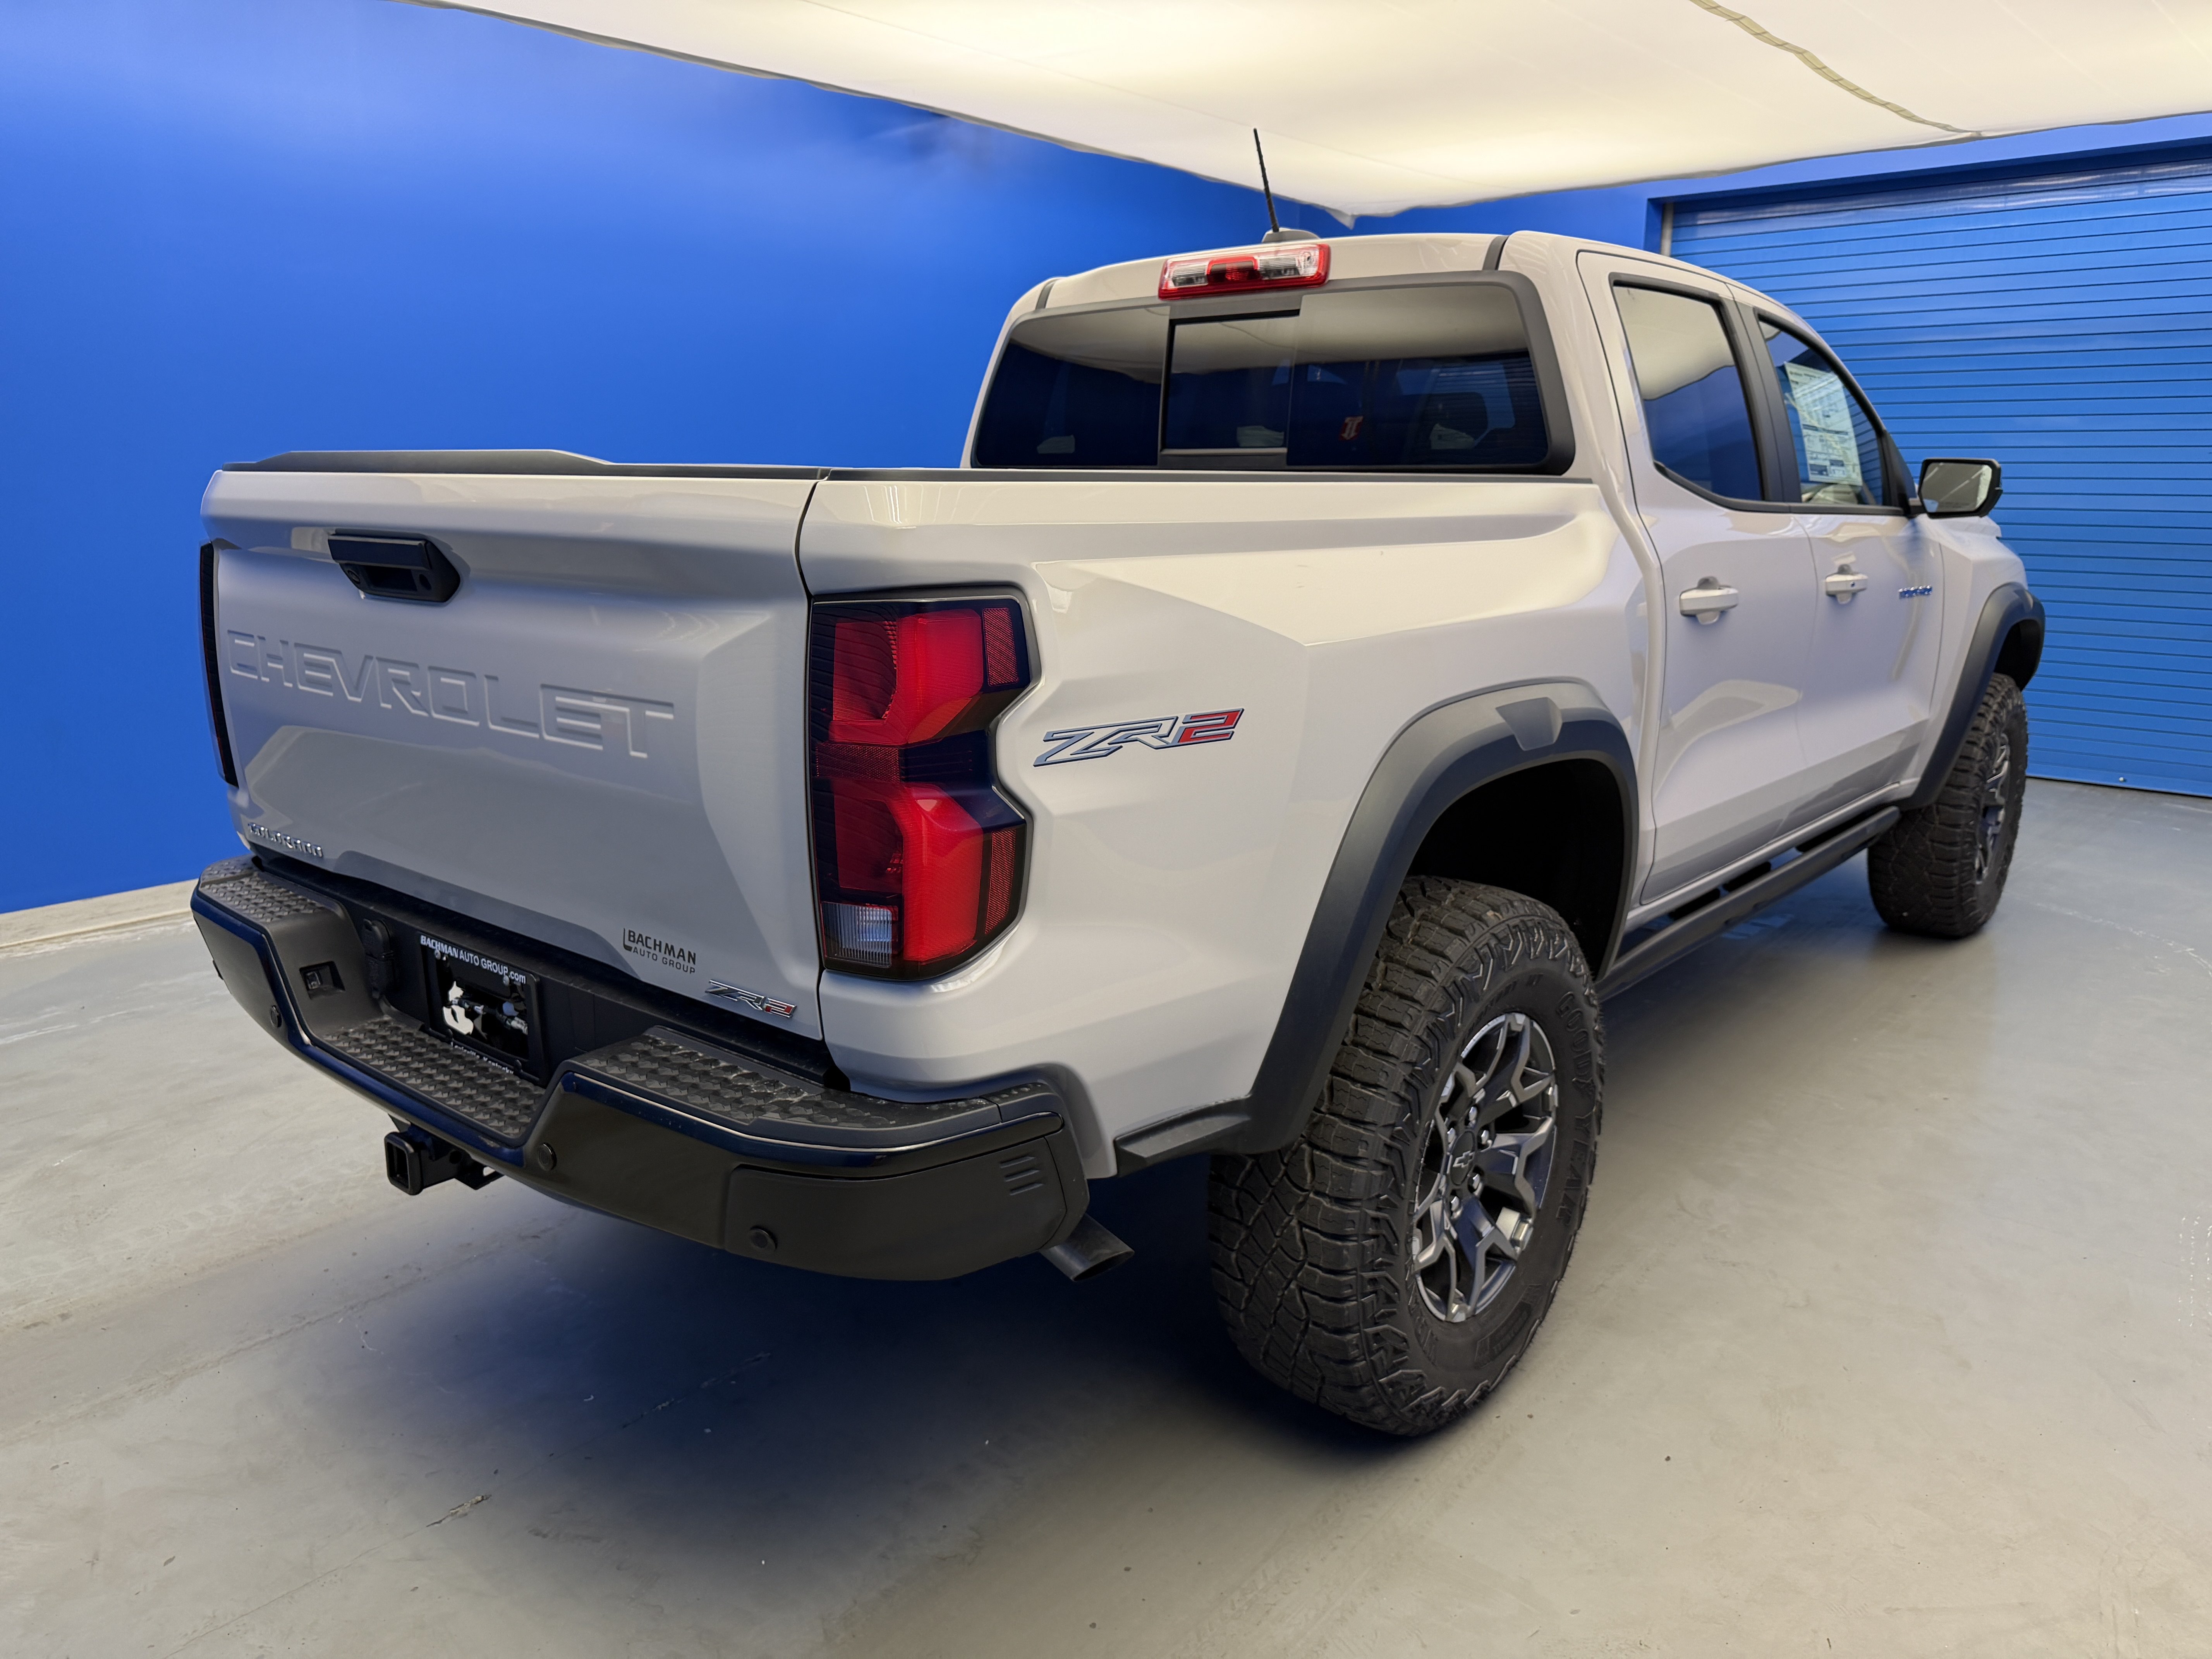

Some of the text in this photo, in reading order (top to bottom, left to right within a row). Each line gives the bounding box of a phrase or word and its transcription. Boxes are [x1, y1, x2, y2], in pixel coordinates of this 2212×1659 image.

[227, 629, 674, 758] CHEVROLET
[1033, 708, 1244, 767] ZR2
[420, 935, 459, 958] BACHMAN
[459, 950, 479, 966] AUTO
[628, 929, 696, 965] BACHMAN
[633, 946, 696, 974] AUTO GROUP
[704, 979, 797, 1018] ZR2
